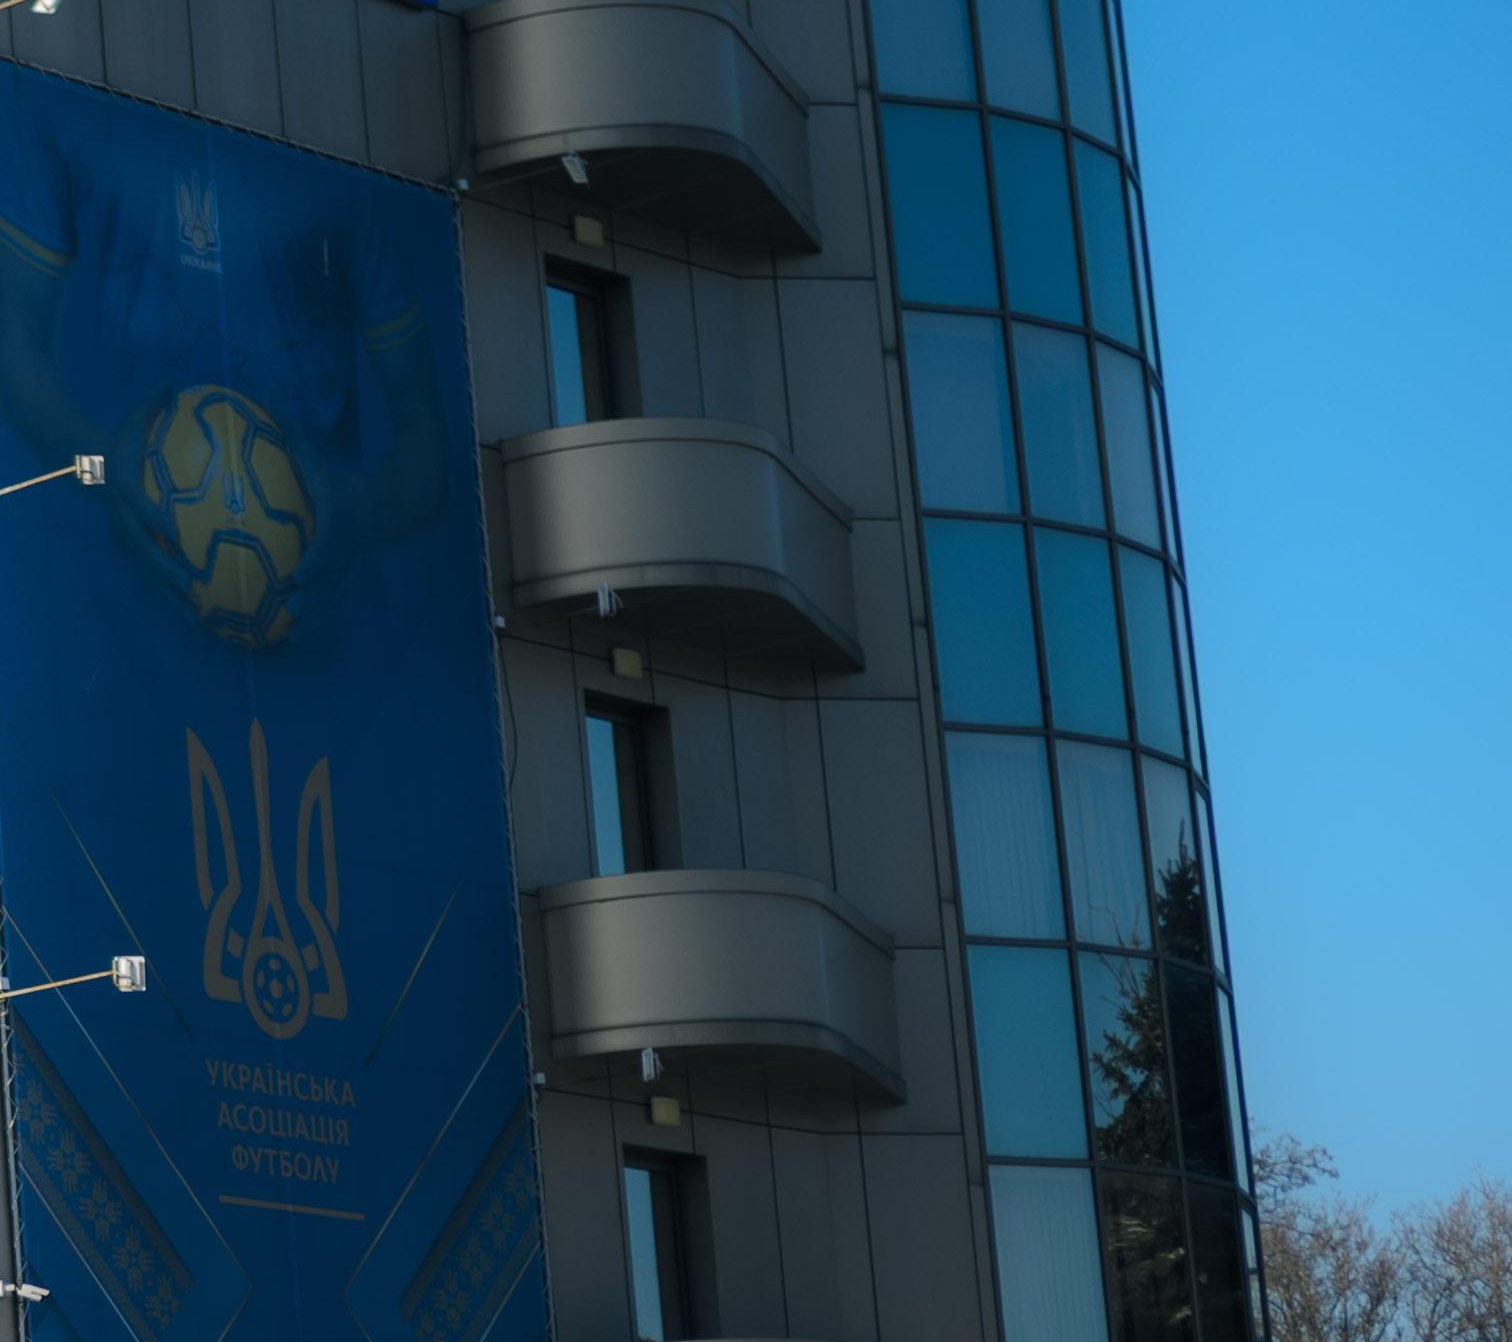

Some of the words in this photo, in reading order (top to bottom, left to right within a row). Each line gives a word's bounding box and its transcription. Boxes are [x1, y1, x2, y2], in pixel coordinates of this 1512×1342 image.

[205, 1057, 357, 1109] УКРАЇНСЬКА
[216, 1098, 351, 1148] АСОЦІАЦІЯ
[231, 1144, 340, 1184] ФУТБОЛУ
